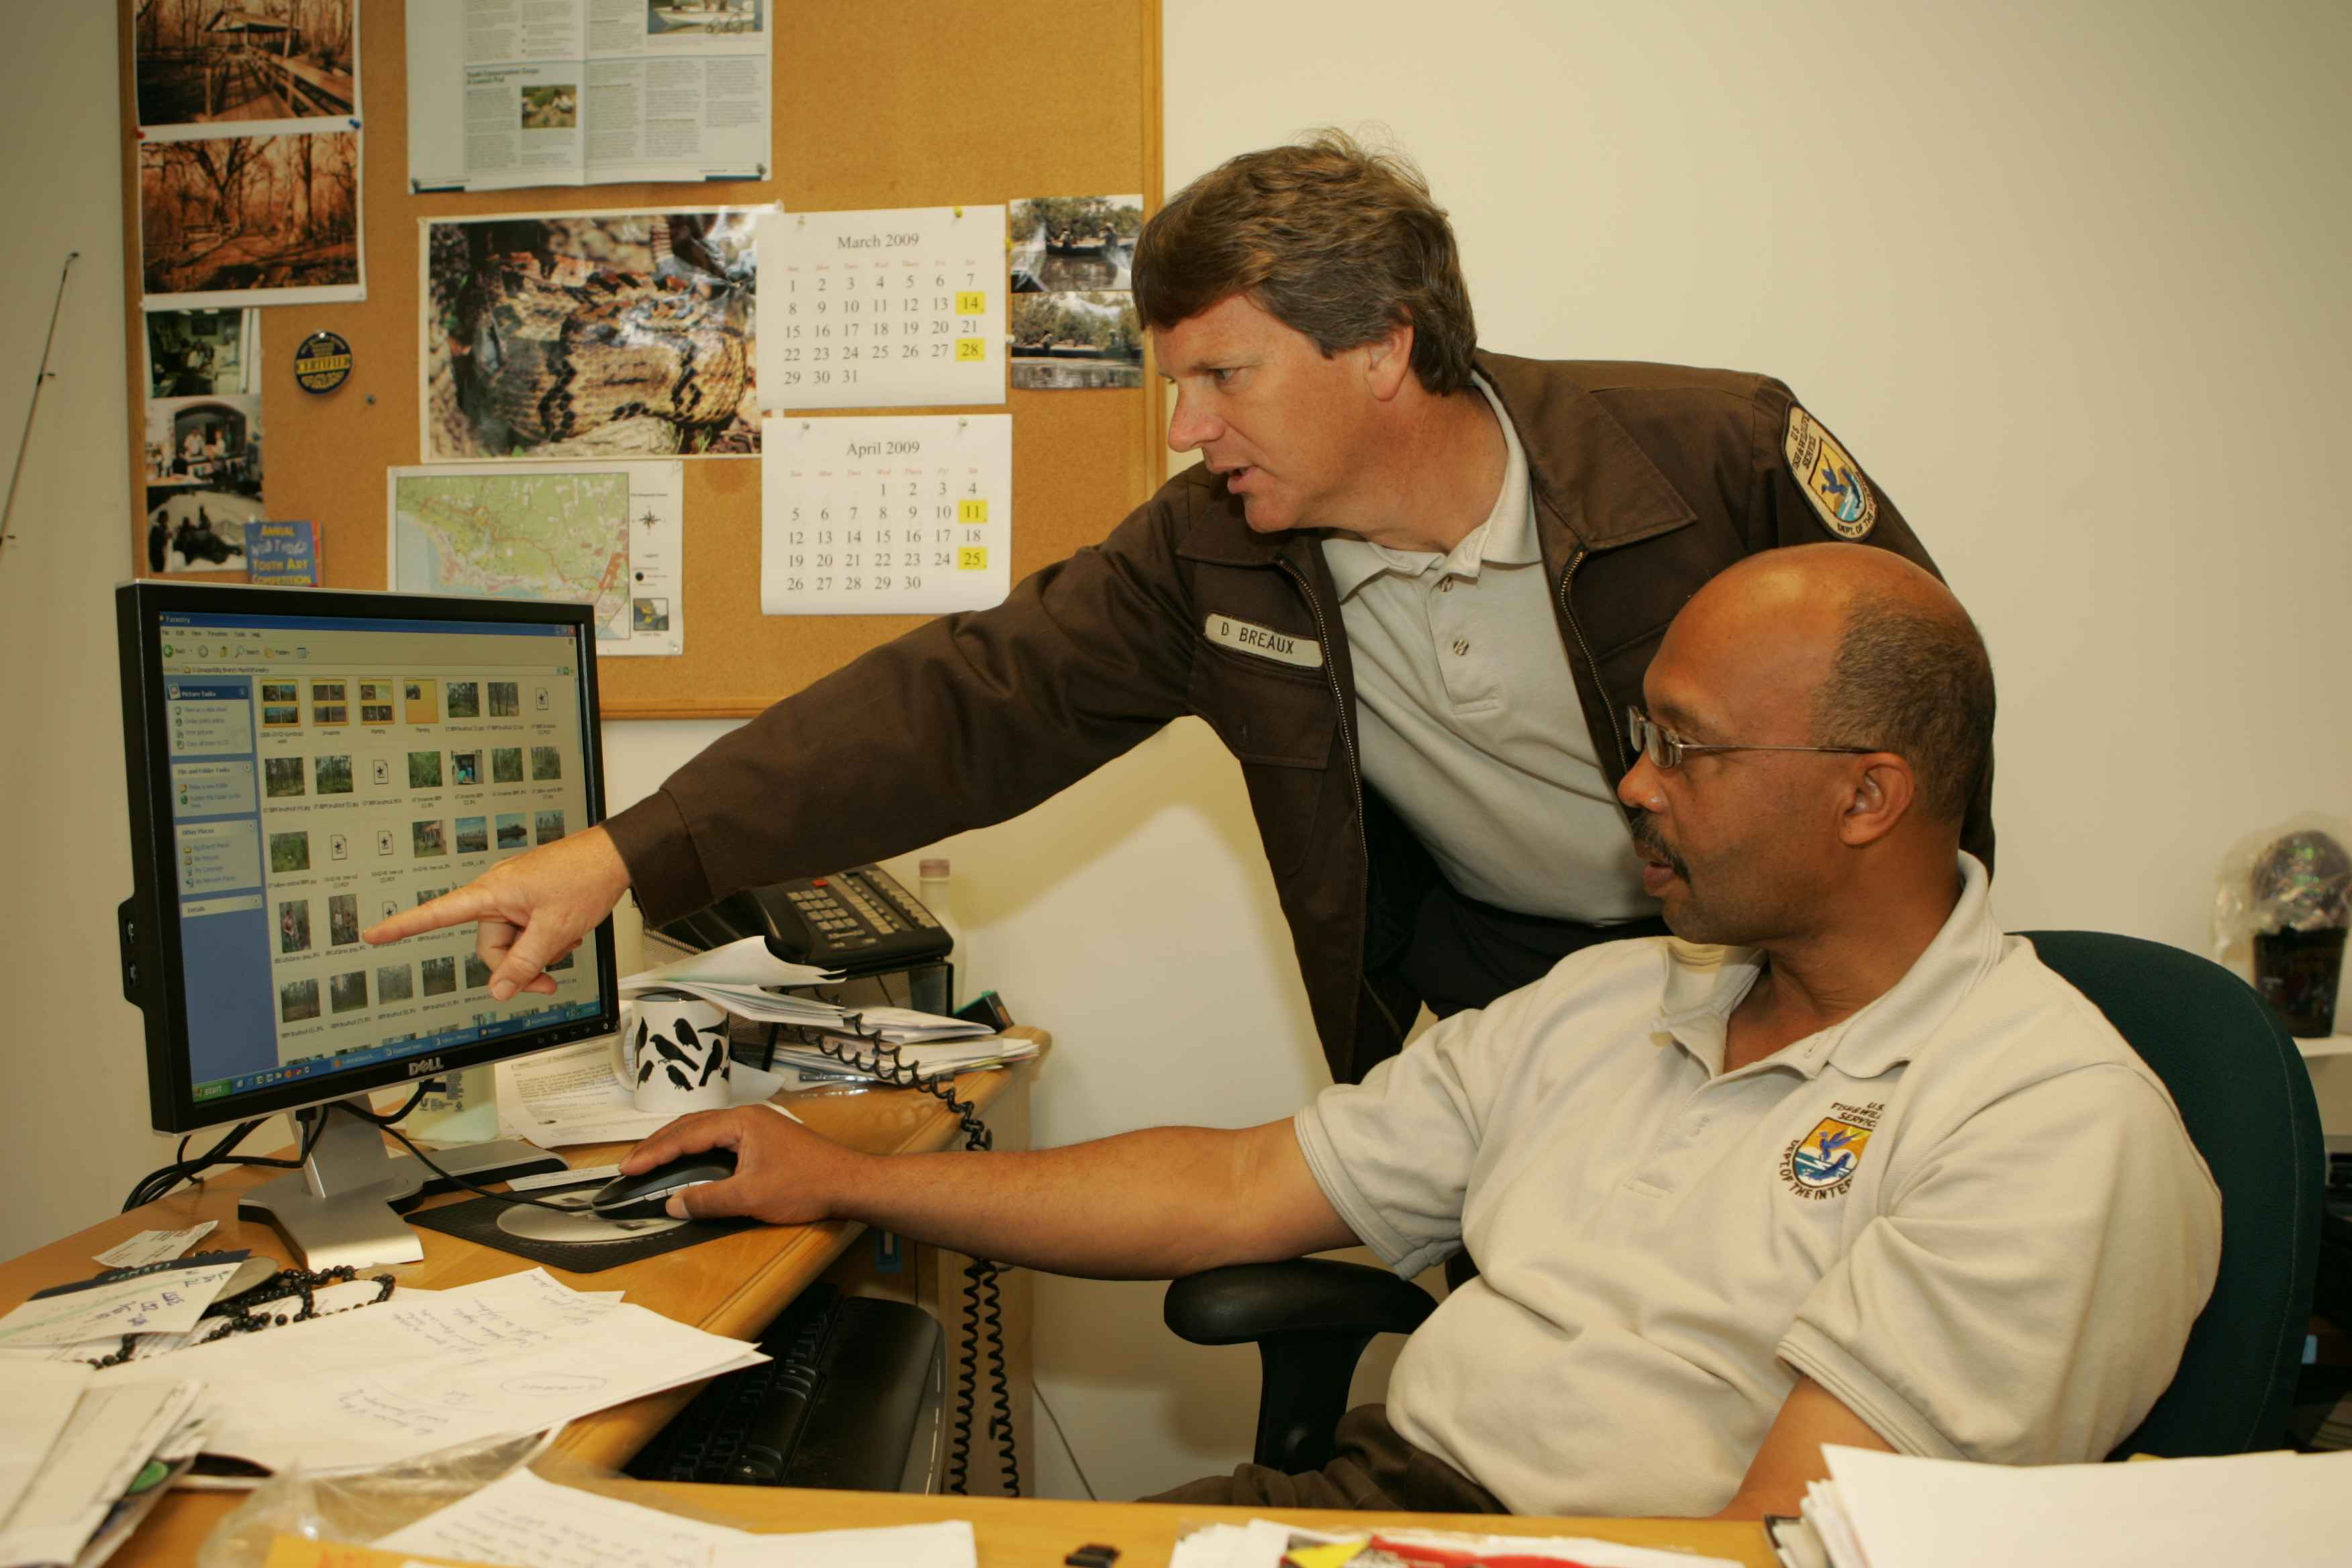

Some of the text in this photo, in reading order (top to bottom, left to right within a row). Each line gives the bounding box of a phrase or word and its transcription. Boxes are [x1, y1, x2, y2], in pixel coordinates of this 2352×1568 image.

[836, 232, 920, 249] March 2009
[789, 273, 974, 292] 1 2 3 4 5 6 7
[789, 296, 979, 315] 8 9 10 11 12 13 14
[787, 320, 977, 339] 15 16 17 18 19 20 21
[784, 343, 979, 362] 22 23 24 25 26 27 28
[784, 369, 858, 385] 29 30 31
[846, 441, 920, 459] April 2009
[880, 481, 977, 496] 1 2 3 4
[792, 505, 980, 522] 5 6 7 8 9 10 11
[789, 528, 981, 545] 12 13 14 15 16 17 18
[789, 551, 981, 568] 19 20 21 22 23 24 25
[787, 575, 922, 591] 26 27 28 29 30
[1220, 622, 1295, 654] D BREAUX
[408, 1057, 444, 1077] DELL
[203, 1085, 223, 1097] start
[1779, 1169, 1794, 1182] OF
[1789, 1181, 1814, 1199] THE
